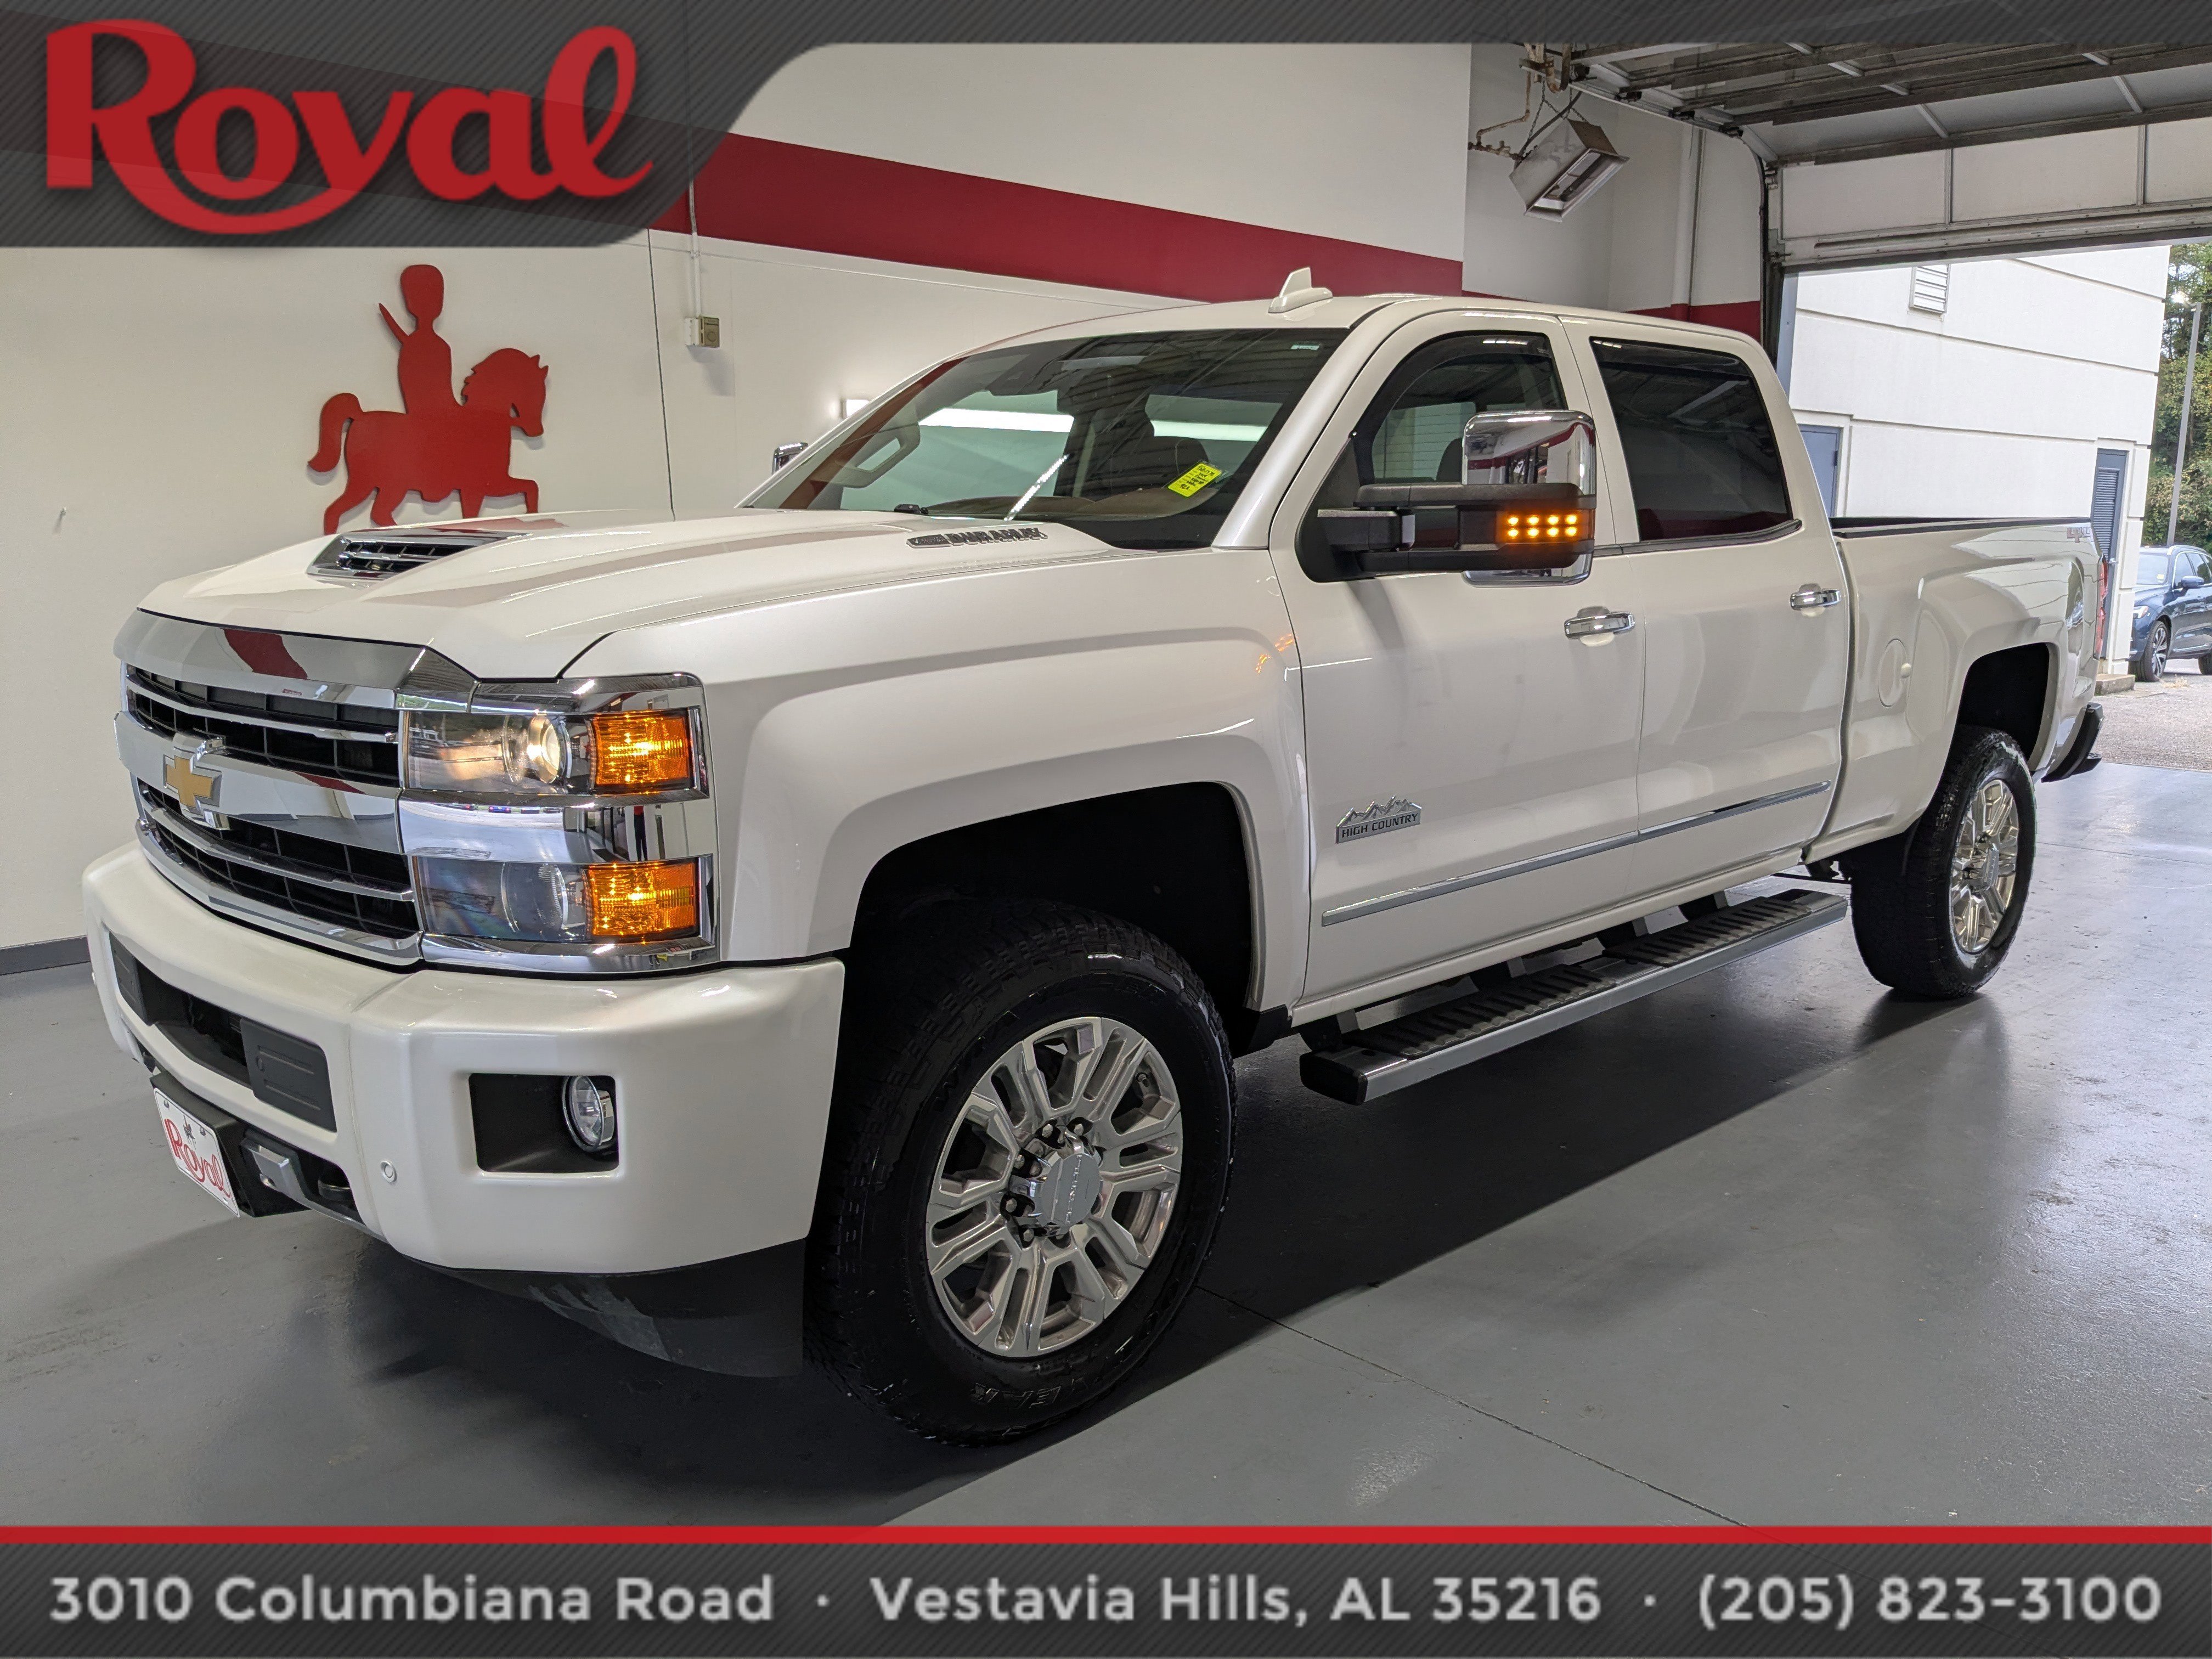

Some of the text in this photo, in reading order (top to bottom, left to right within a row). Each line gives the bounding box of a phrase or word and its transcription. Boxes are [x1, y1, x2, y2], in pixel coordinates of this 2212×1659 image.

[944, 527, 1048, 546] DURAMAX
[1341, 812, 1418, 838] HIGH COUNTRY
[164, 1118, 232, 1198] Royal
